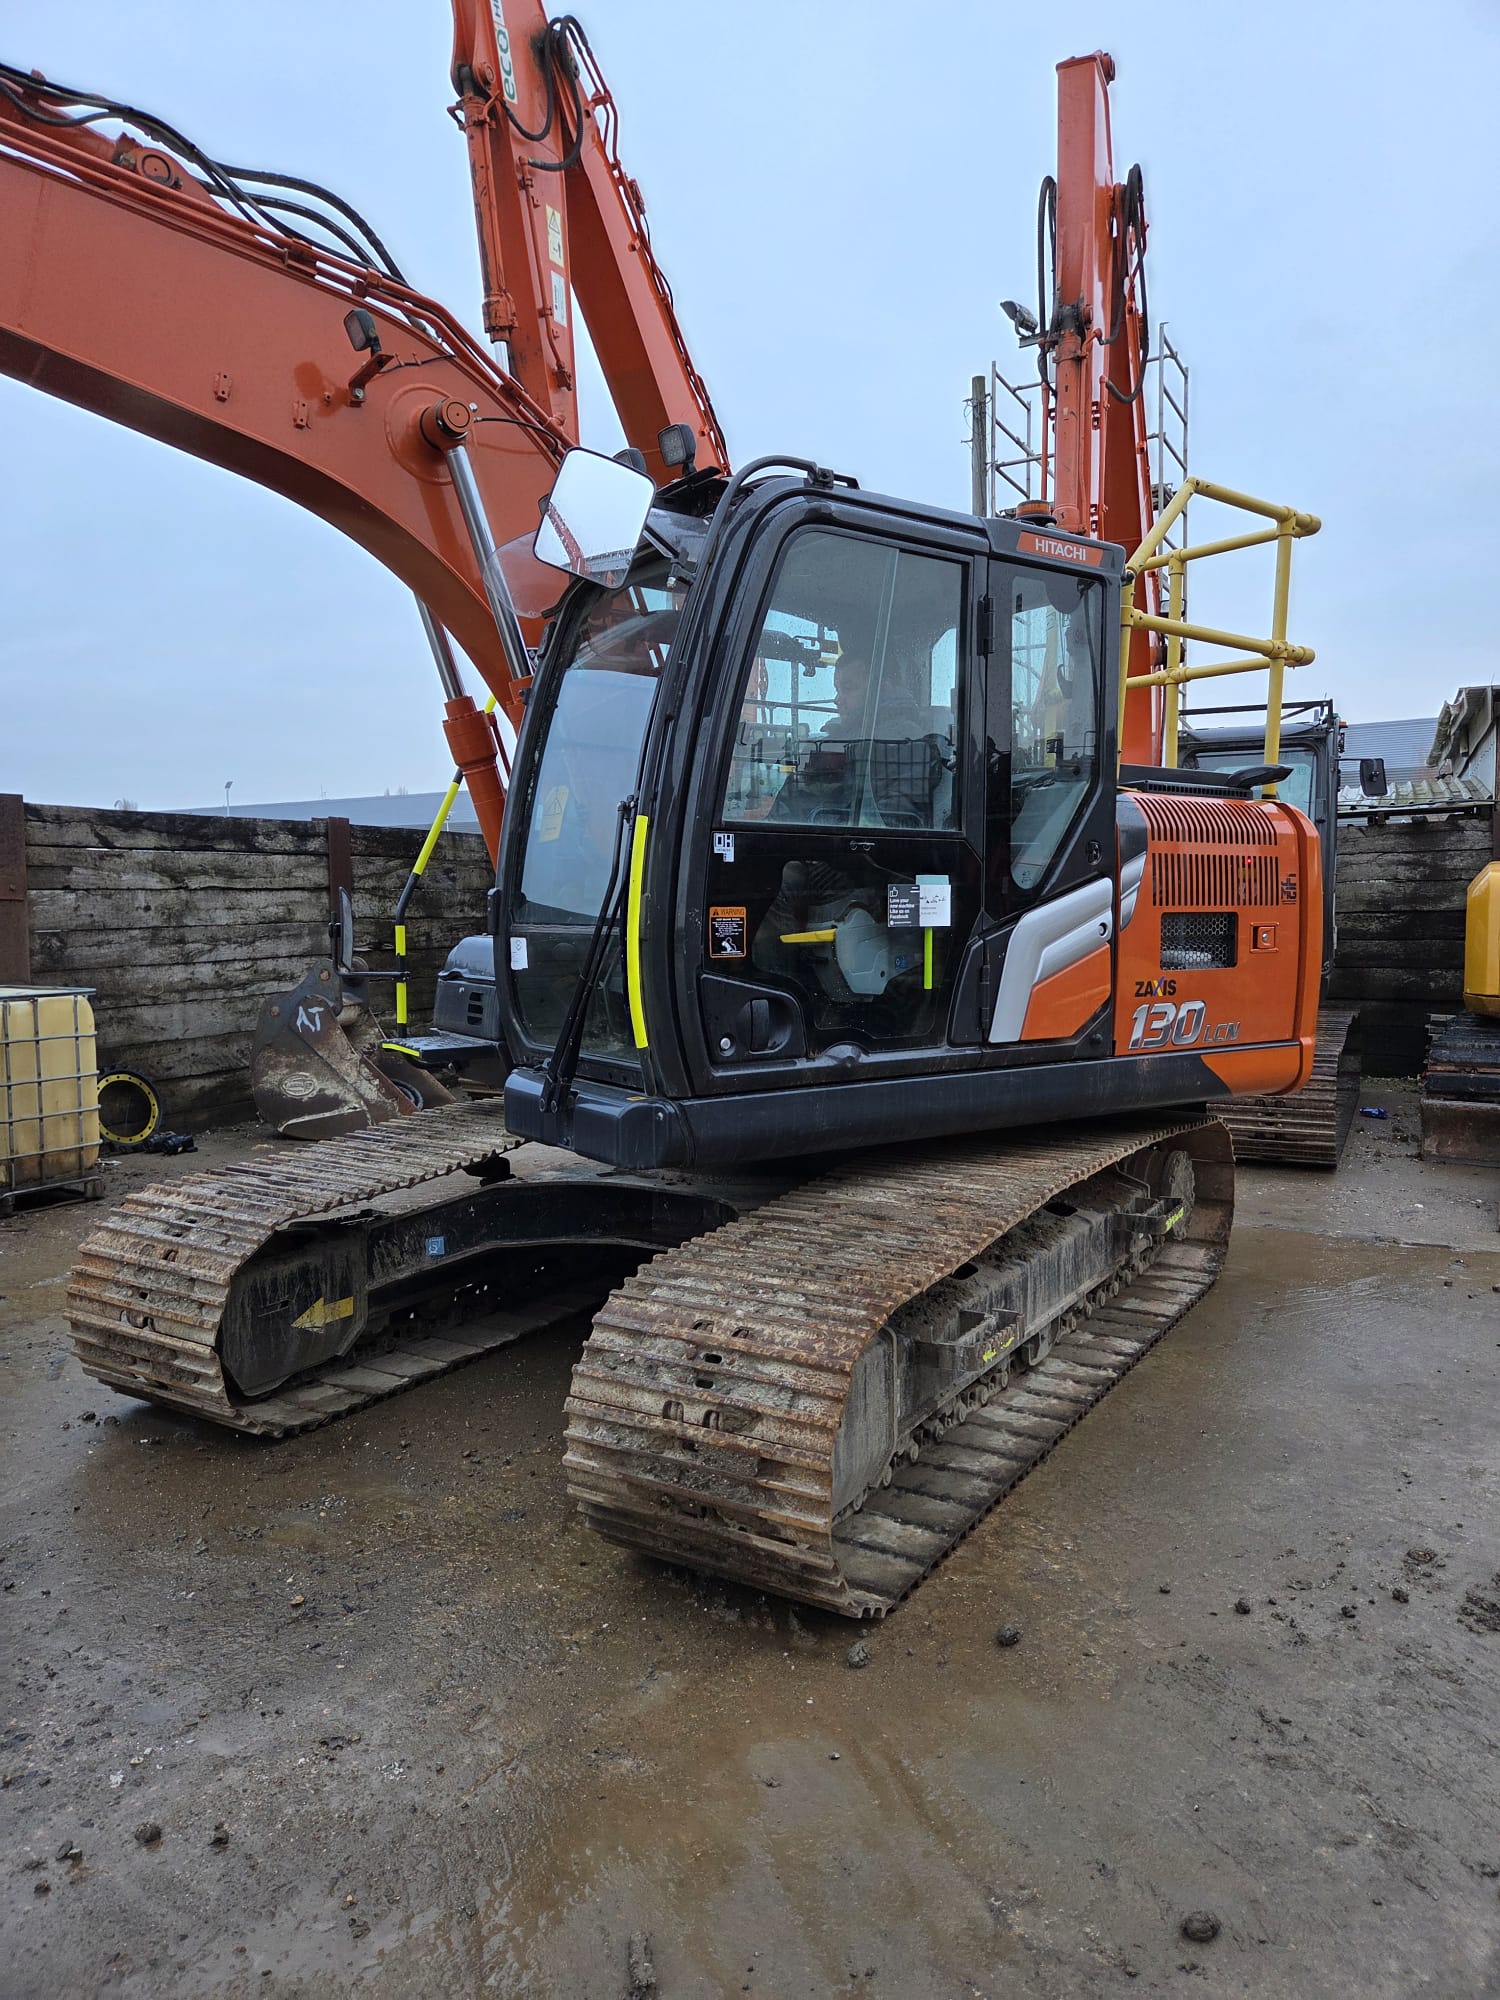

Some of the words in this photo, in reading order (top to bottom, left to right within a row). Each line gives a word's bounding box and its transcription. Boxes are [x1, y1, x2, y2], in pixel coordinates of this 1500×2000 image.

[1035, 537, 1086, 561] HITACHI
[721, 908, 745, 916] WARNING
[1135, 976, 1177, 998] ZAXIS
[296, 1006, 325, 1032] AT
[1128, 1000, 1206, 1050] 130
[1204, 1022, 1240, 1043] LCN
